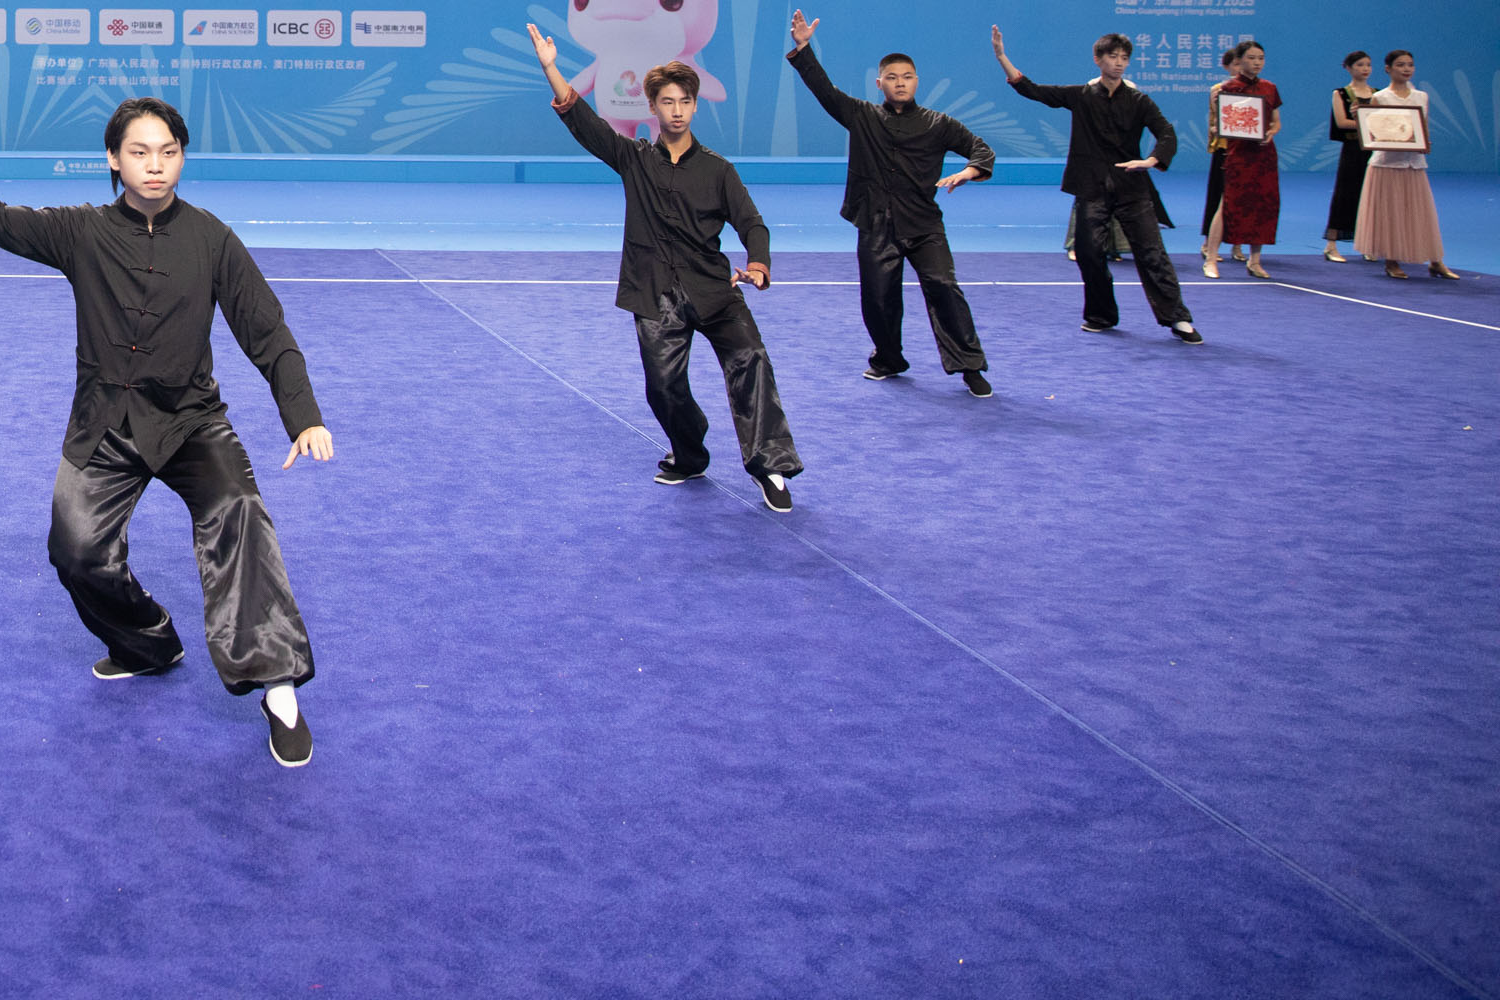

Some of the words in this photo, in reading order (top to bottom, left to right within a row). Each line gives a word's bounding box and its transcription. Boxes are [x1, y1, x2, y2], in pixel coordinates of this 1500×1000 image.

[46, 18, 81, 28] 中国移动
[131, 21, 163, 29] 中国联通
[212, 22, 255, 30] 中国南方航空
[273, 23, 309, 34] ICBC
[374, 24, 423, 32] 中国南方电网
